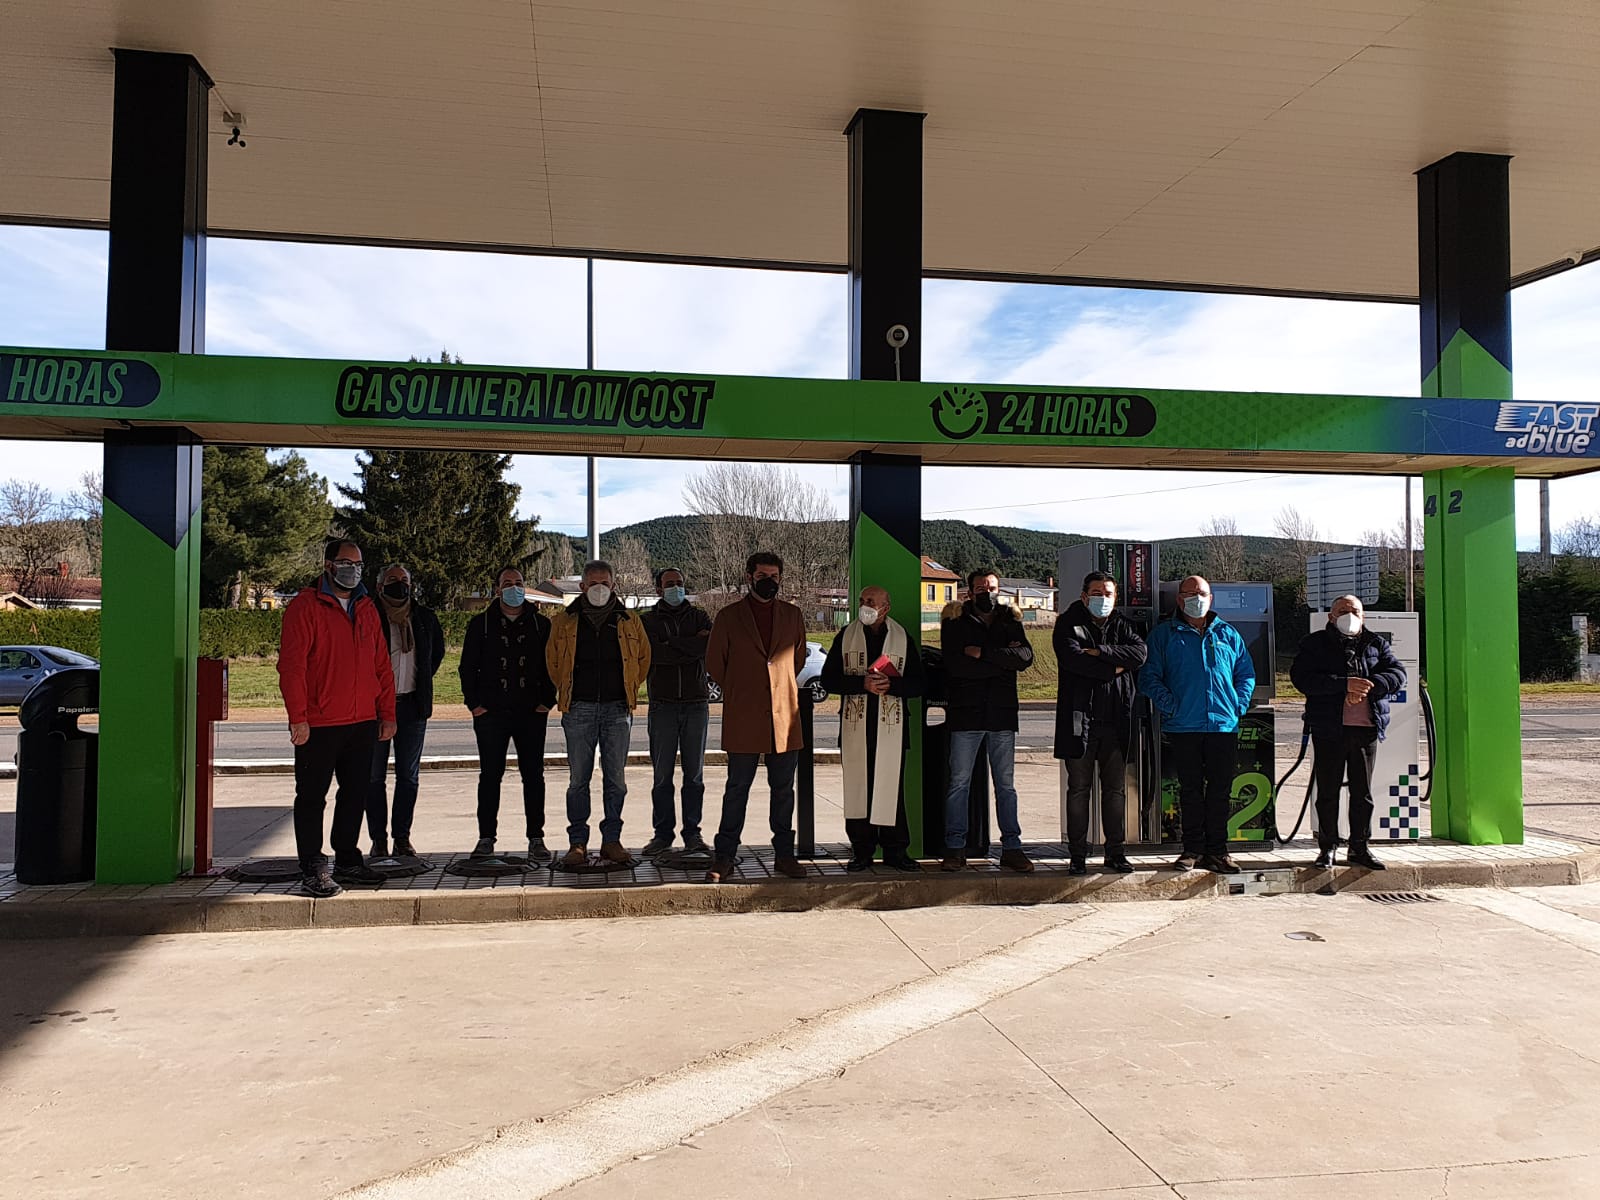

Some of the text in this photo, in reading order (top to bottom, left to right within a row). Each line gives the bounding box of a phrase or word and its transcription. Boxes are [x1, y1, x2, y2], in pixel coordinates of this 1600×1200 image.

[7, 357, 128, 405] HORAS
[342, 371, 708, 425] GASOLINERA LOW COST
[998, 395, 1131, 435] 24 HORAS
[1496, 403, 1600, 432] FAST
[1423, 494, 1437, 517] 4
[1447, 489, 1463, 515] 2
[1226, 771, 1272, 842] 2
